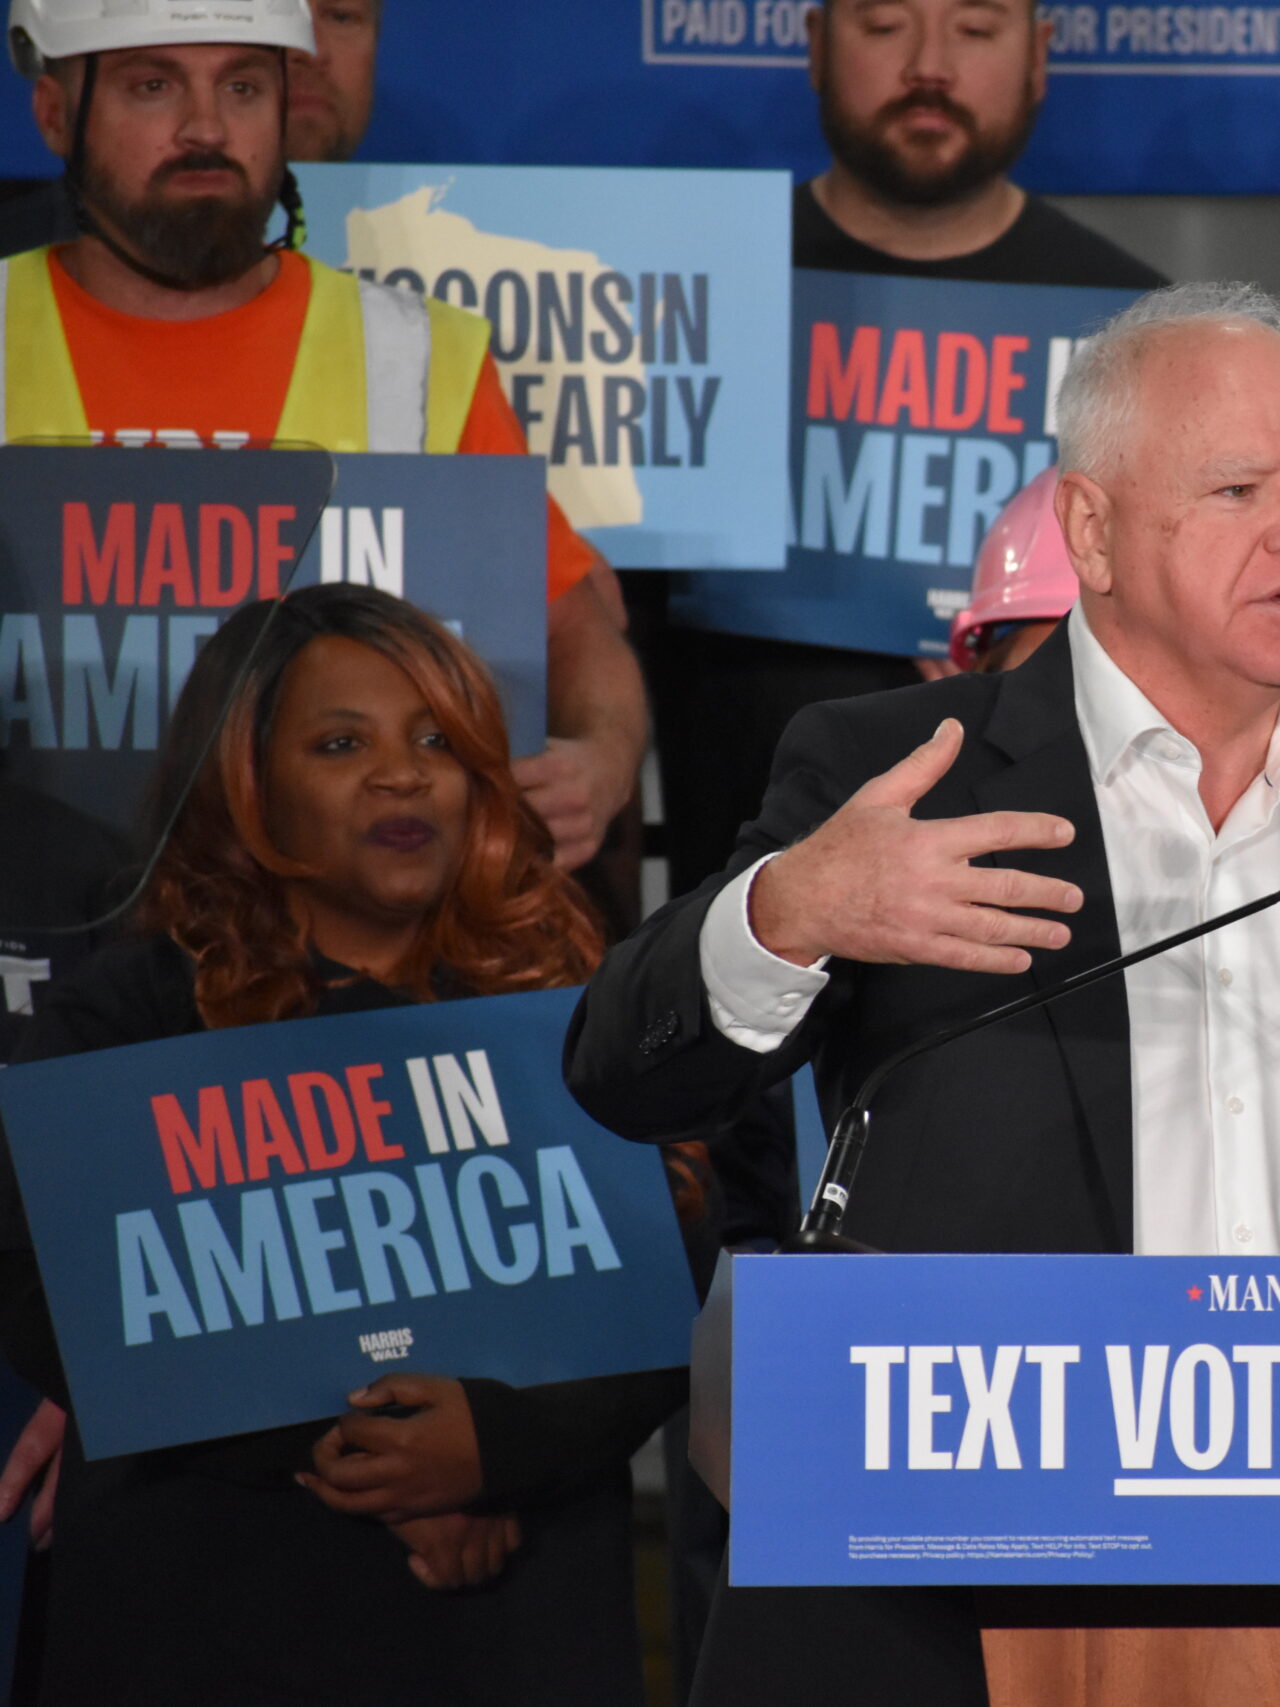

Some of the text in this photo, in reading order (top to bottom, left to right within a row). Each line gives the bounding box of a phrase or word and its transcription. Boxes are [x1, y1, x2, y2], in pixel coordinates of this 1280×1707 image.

[662, 0, 746, 45] PAID
[806, 322, 1030, 434] MADE
[62, 501, 404, 606] MADE IN
[150, 1049, 510, 1195] MADE IN
[115, 1145, 622, 1347] AMERICA
[359, 1327, 414, 1353] HARRIS
[370, 1346, 410, 1363] WALZ
[850, 1345, 1080, 1470] TEXT
